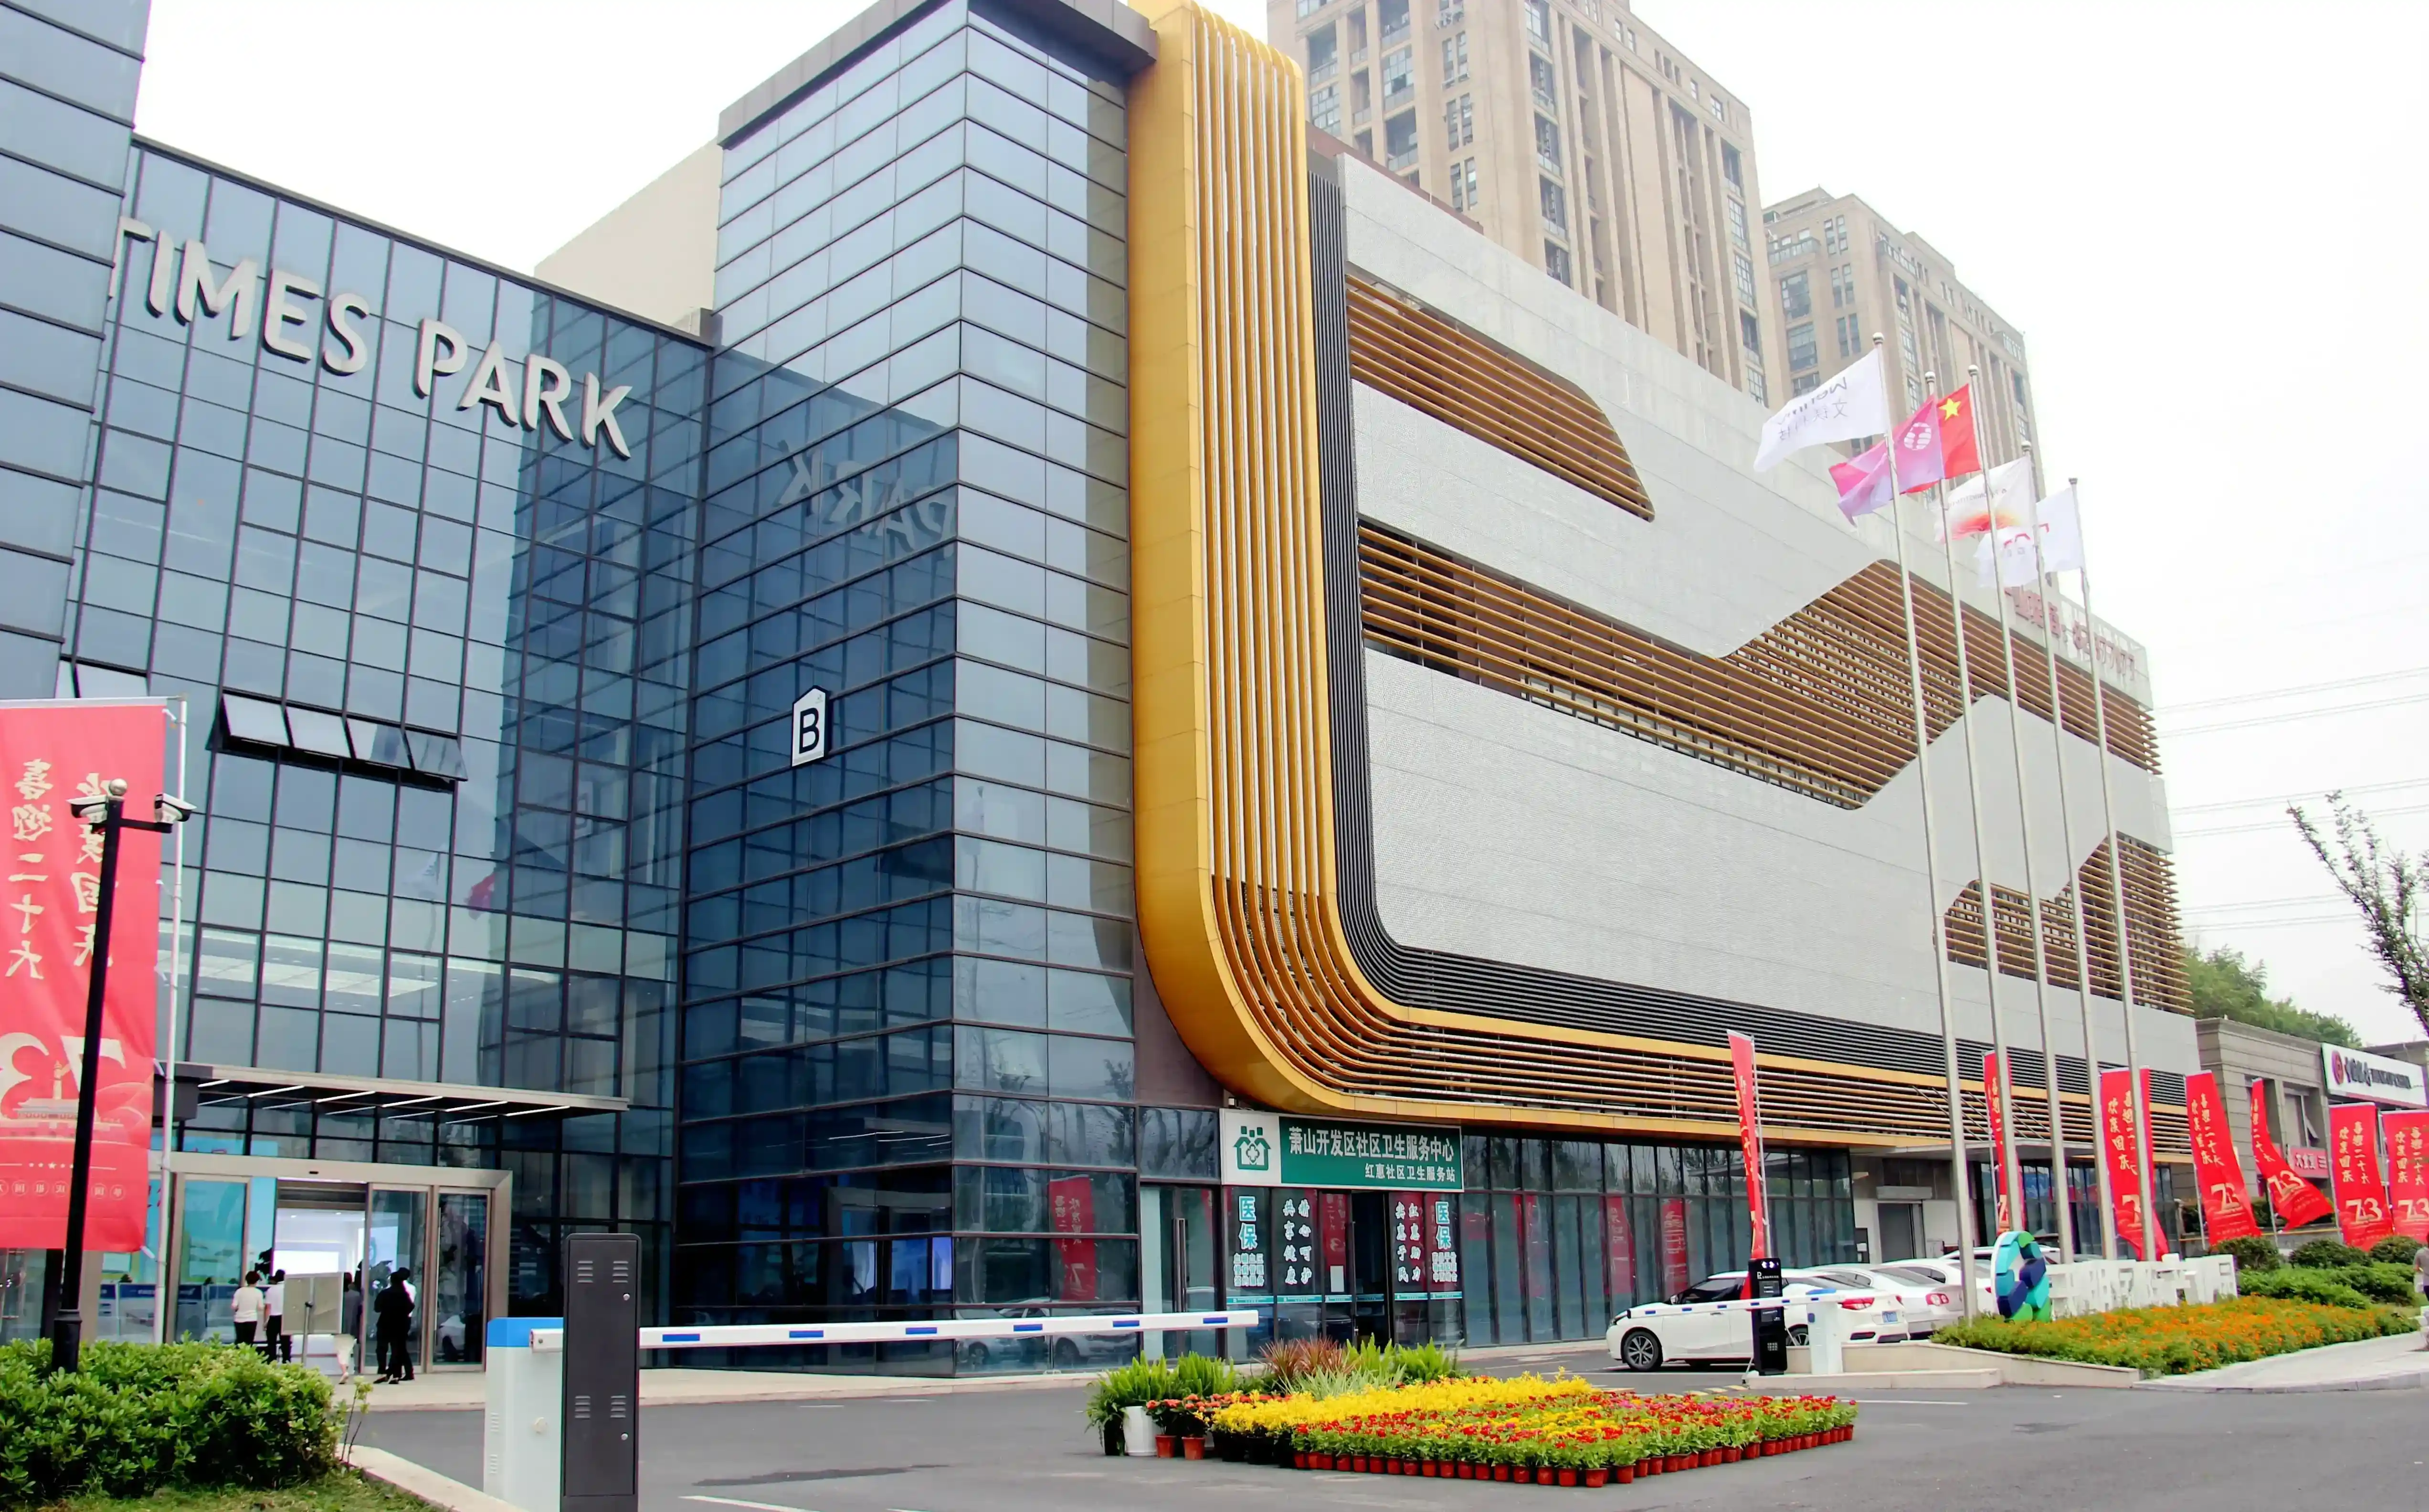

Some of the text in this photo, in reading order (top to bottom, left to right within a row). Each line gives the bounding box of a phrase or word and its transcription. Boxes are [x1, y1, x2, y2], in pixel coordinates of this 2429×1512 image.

[109, 216, 632, 460] TIMES PARK
[799, 708, 819, 754] B
[1289, 1126, 1454, 1162] 萧山开发区社区卫生服务中心
[1365, 1163, 1456, 1182] 红惠社区卫生服务站
[2267, 1170, 2306, 1204] 73
[1239, 1196, 1258, 1250] 医保
[1435, 1202, 1452, 1250] 医保
[2345, 1197, 2383, 1225] 73
[2398, 1197, 2429, 1223] 73
